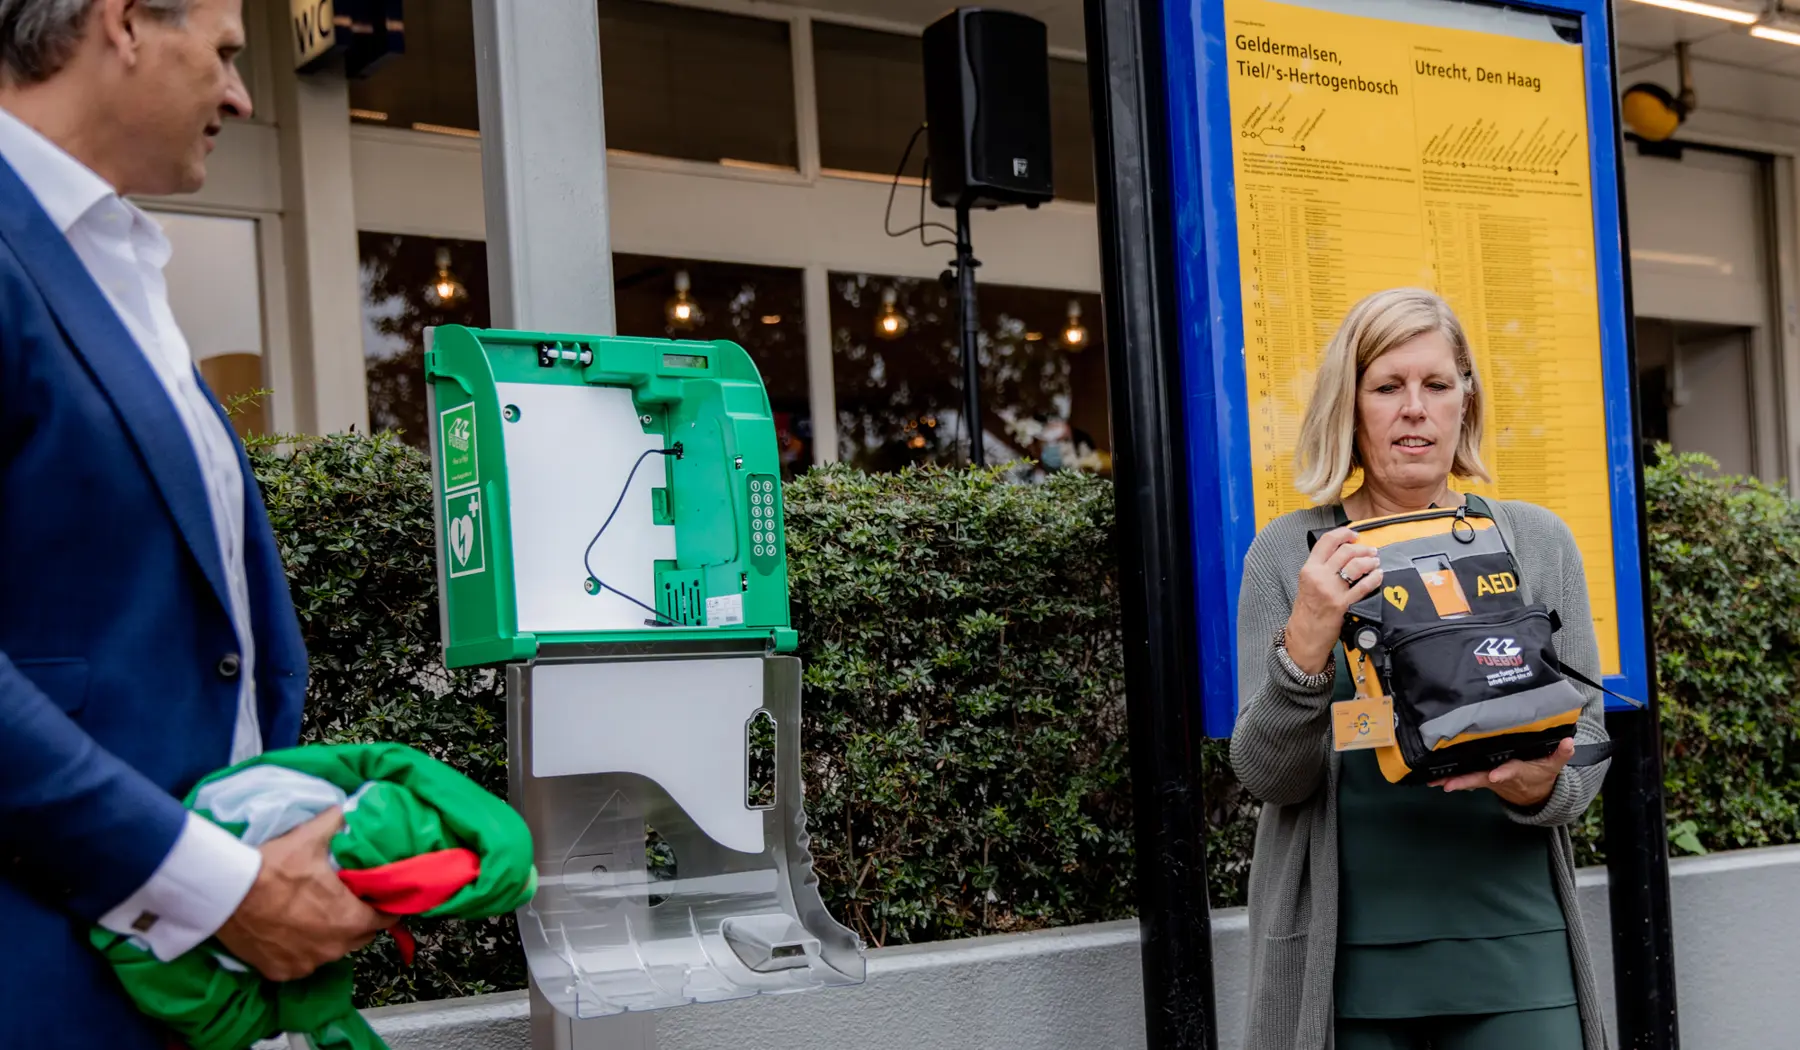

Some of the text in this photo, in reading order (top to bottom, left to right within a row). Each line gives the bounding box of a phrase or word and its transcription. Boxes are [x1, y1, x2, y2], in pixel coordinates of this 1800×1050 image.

[295, 0, 330, 54] WC
[1235, 34, 1342, 66] Geldermalsen,
[1237, 60, 1399, 95] Tiel/'s-Hertogenbosch
[1415, 60, 1541, 92] Utrecht, Den Haag
[1477, 572, 1517, 597] AED
